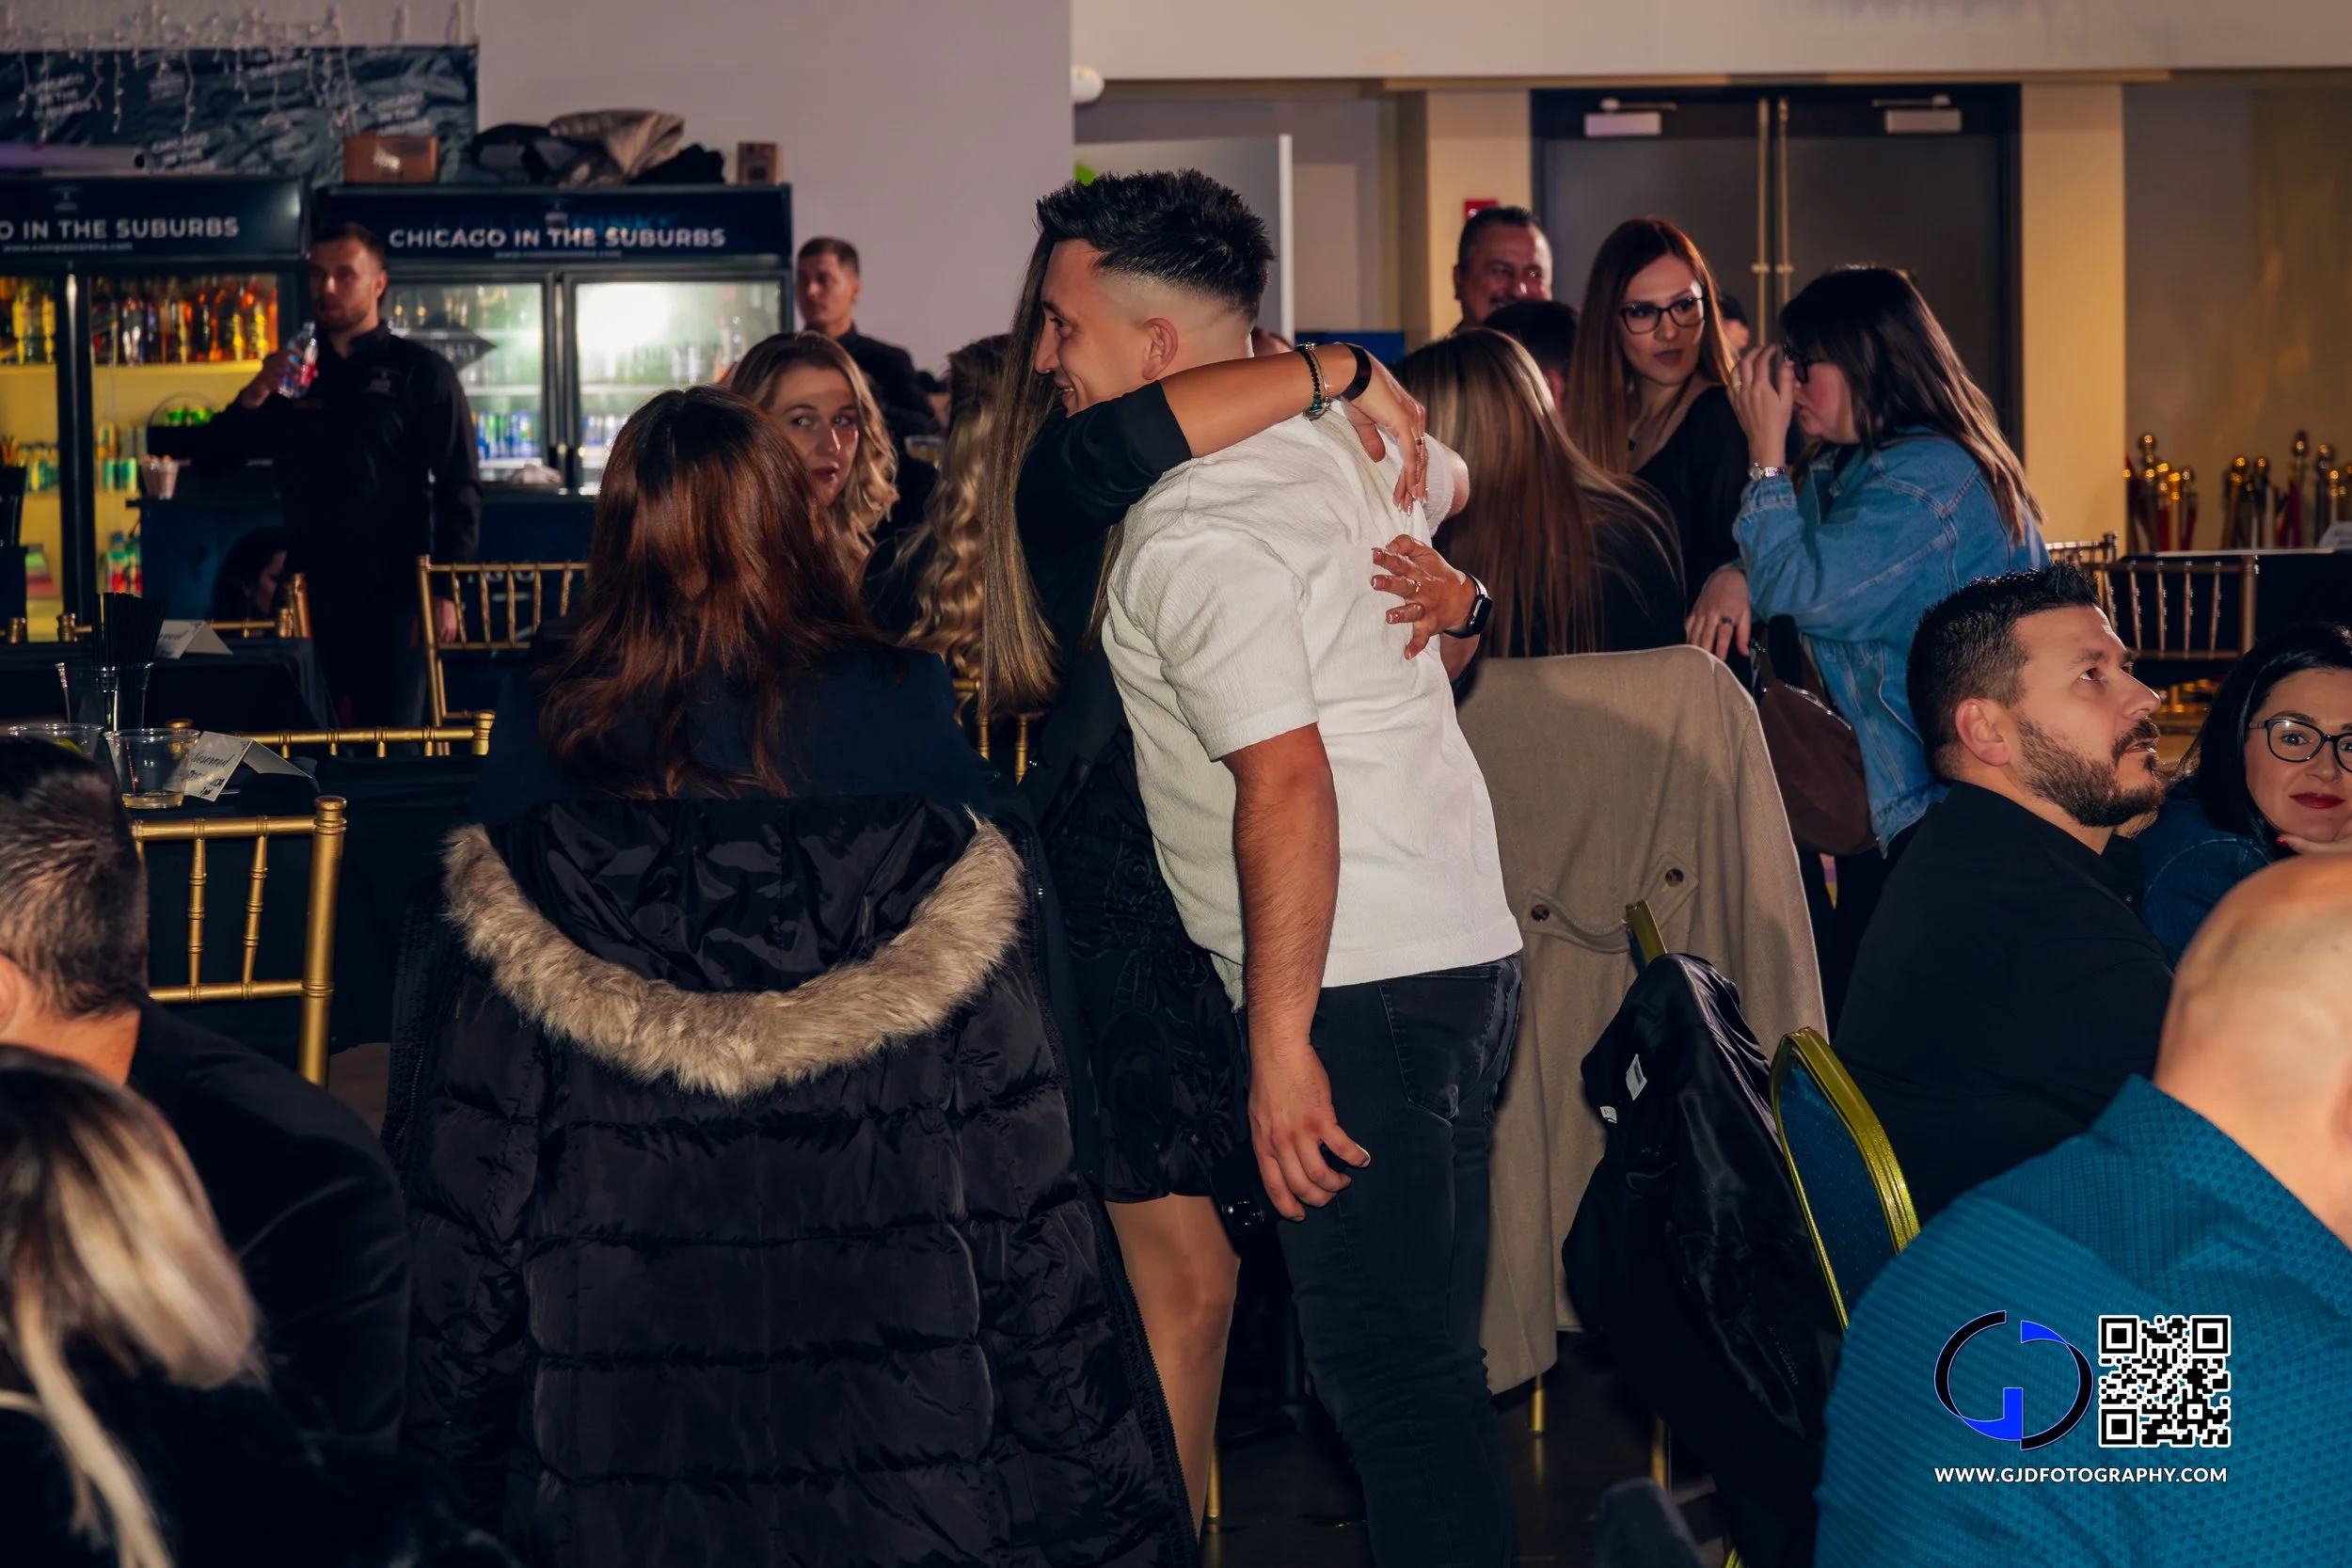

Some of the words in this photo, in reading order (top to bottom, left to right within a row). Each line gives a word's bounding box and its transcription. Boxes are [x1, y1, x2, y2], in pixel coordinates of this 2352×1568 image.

[23, 219, 49, 240] IN
[57, 218, 108, 240] THE
[116, 216, 239, 239] SUBURBS
[389, 229, 506, 248] CHICAGO
[515, 229, 540, 247] IN
[547, 227, 597, 247] THE
[605, 227, 726, 247] SUBURBS
